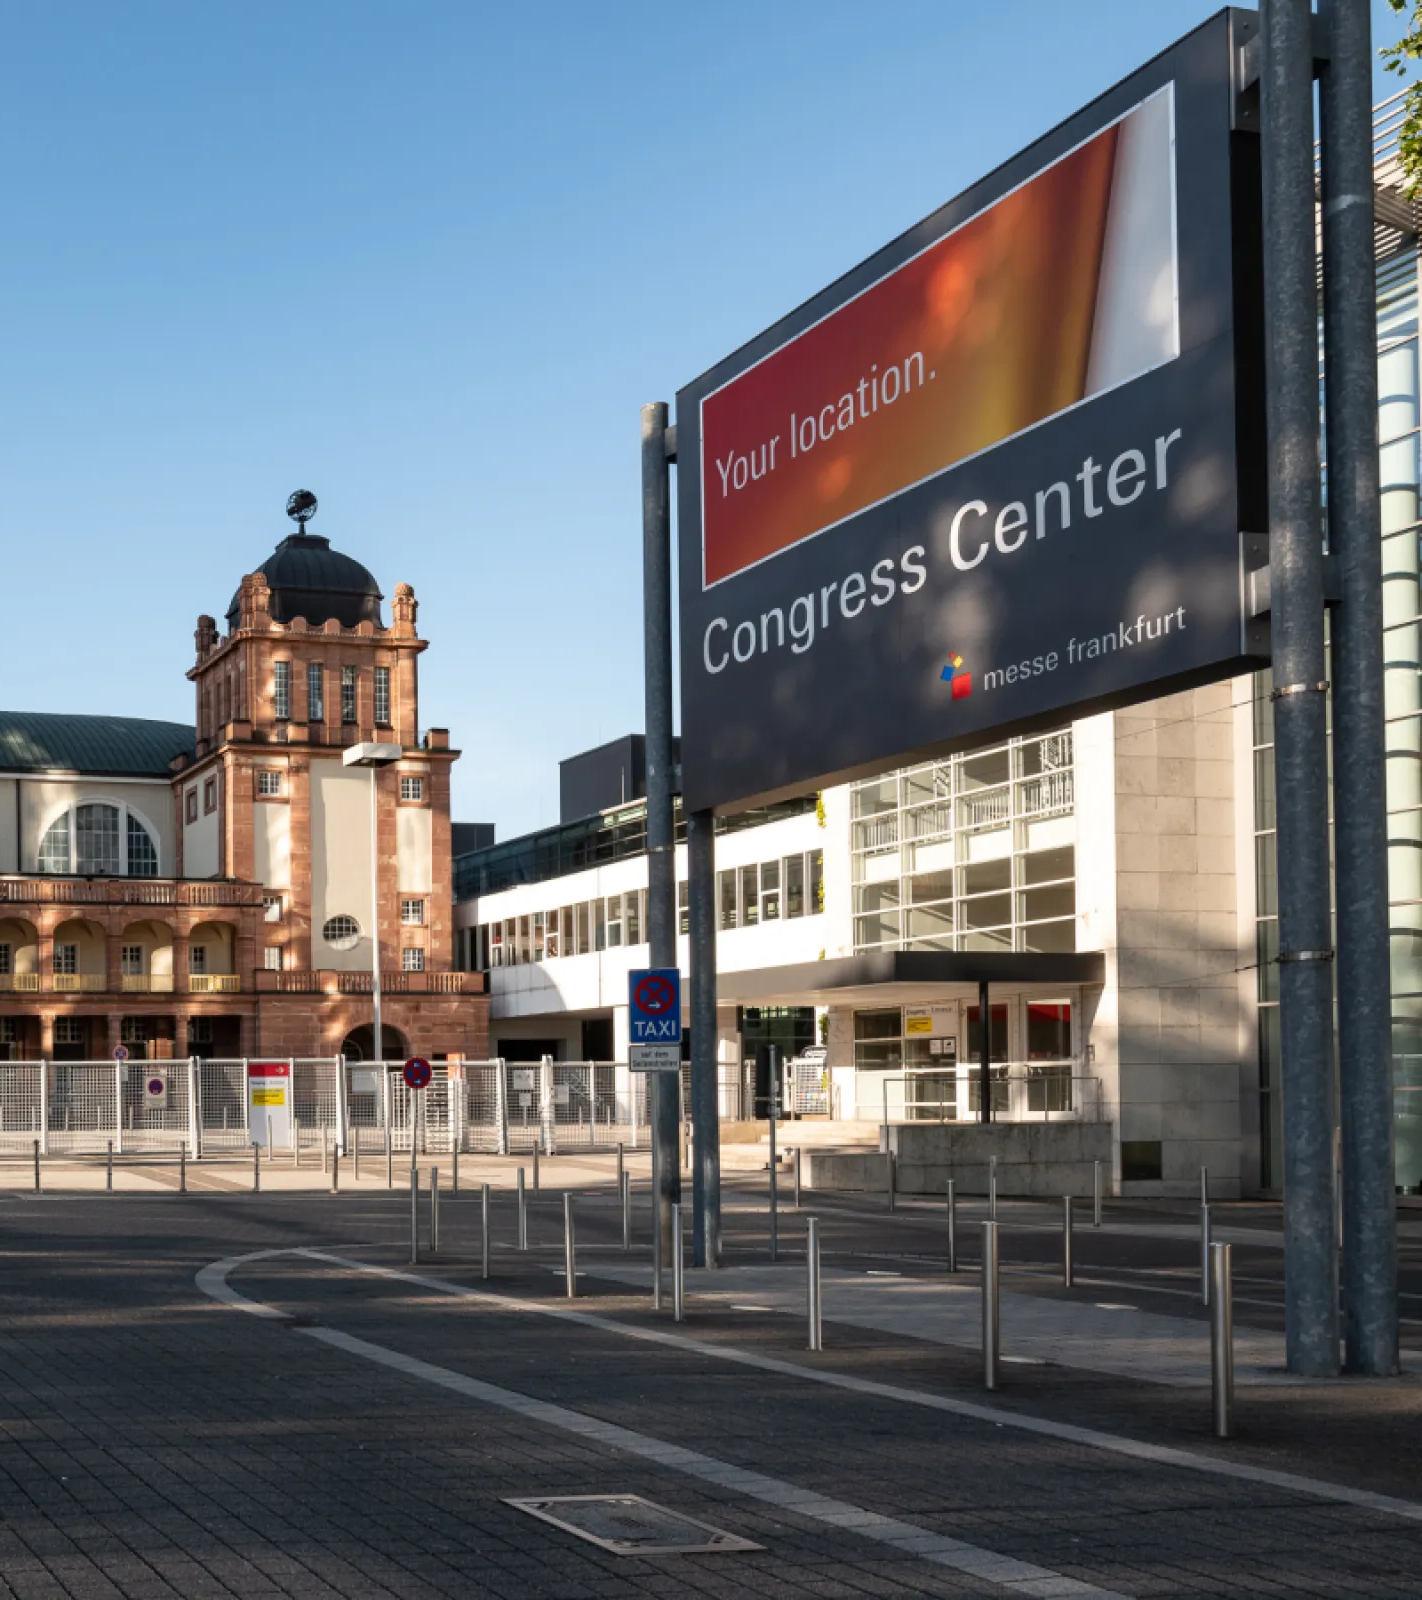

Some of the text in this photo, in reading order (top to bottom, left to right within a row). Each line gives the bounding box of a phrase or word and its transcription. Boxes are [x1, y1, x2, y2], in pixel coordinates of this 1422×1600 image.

[716, 351, 936, 498] Your location.
[703, 428, 1182, 674] Congress Center
[984, 606, 1187, 690] messe frankfurt
[634, 1020, 676, 1036] TAXI
